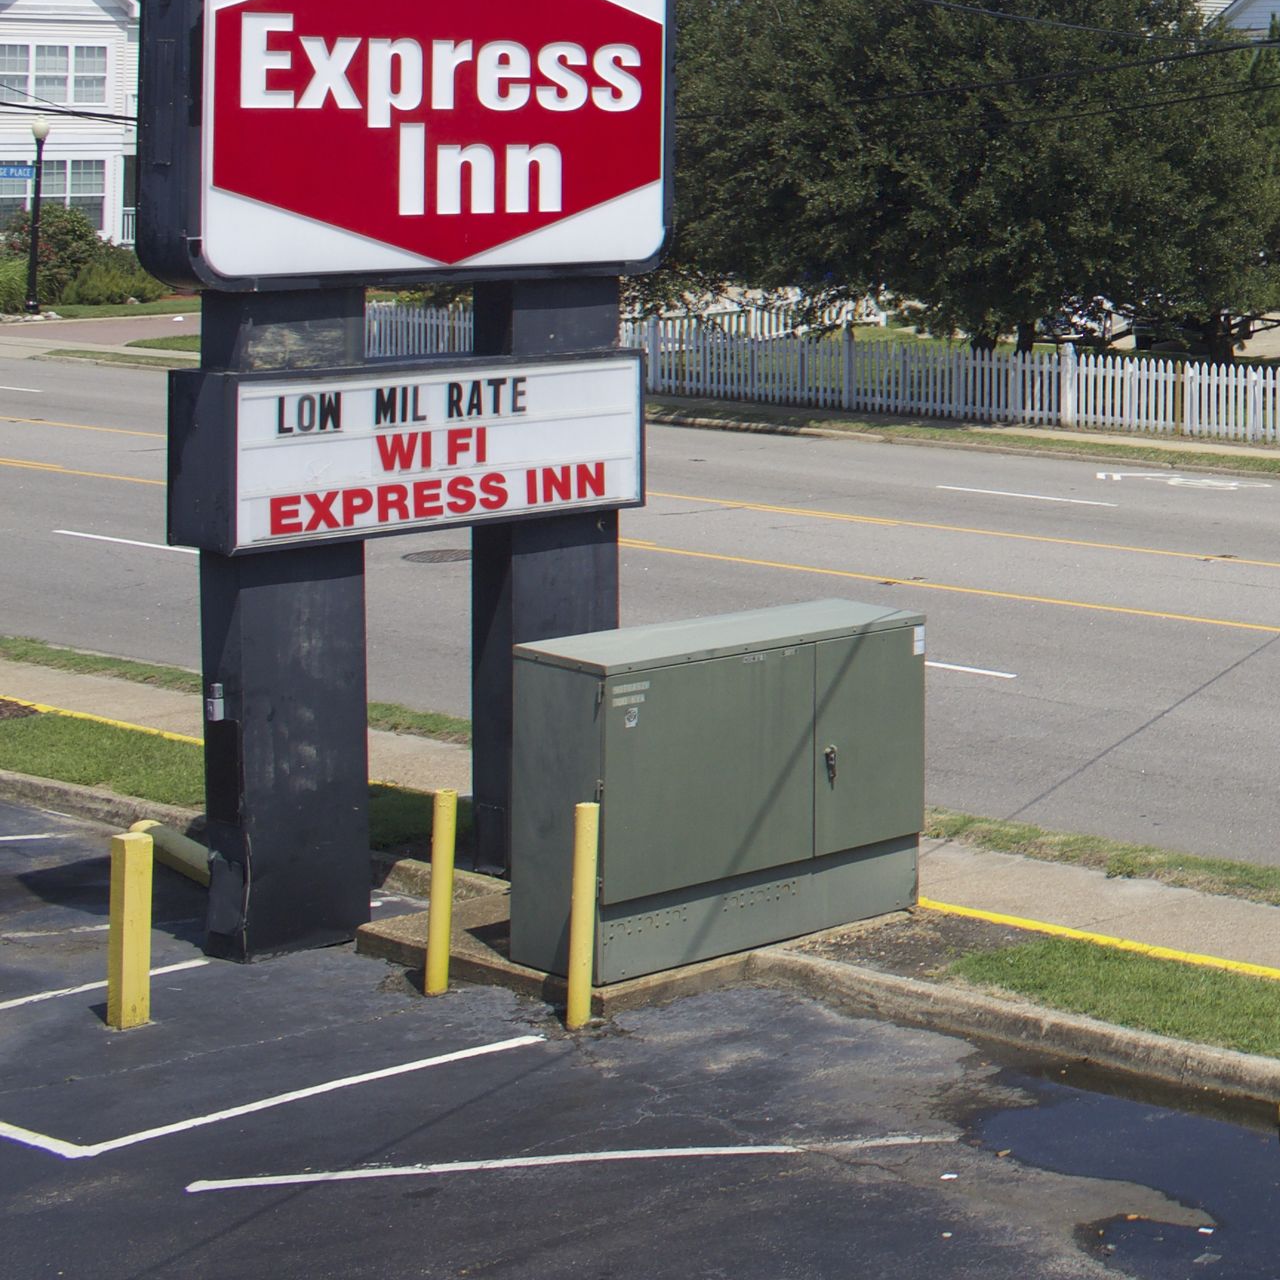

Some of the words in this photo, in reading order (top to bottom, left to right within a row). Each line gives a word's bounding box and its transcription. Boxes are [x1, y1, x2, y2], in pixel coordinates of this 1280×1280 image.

[240, 12, 642, 129] Express
[10, 167, 31, 177] PLACE
[398, 122, 563, 216] Inn
[278, 391, 342, 434] LOW
[374, 384, 427, 426] MIL
[448, 376, 527, 419] RATE
[375, 430, 432, 472] WI
[447, 427, 487, 466] FI
[269, 472, 509, 535] EXPRESS
[526, 462, 606, 505] INN
